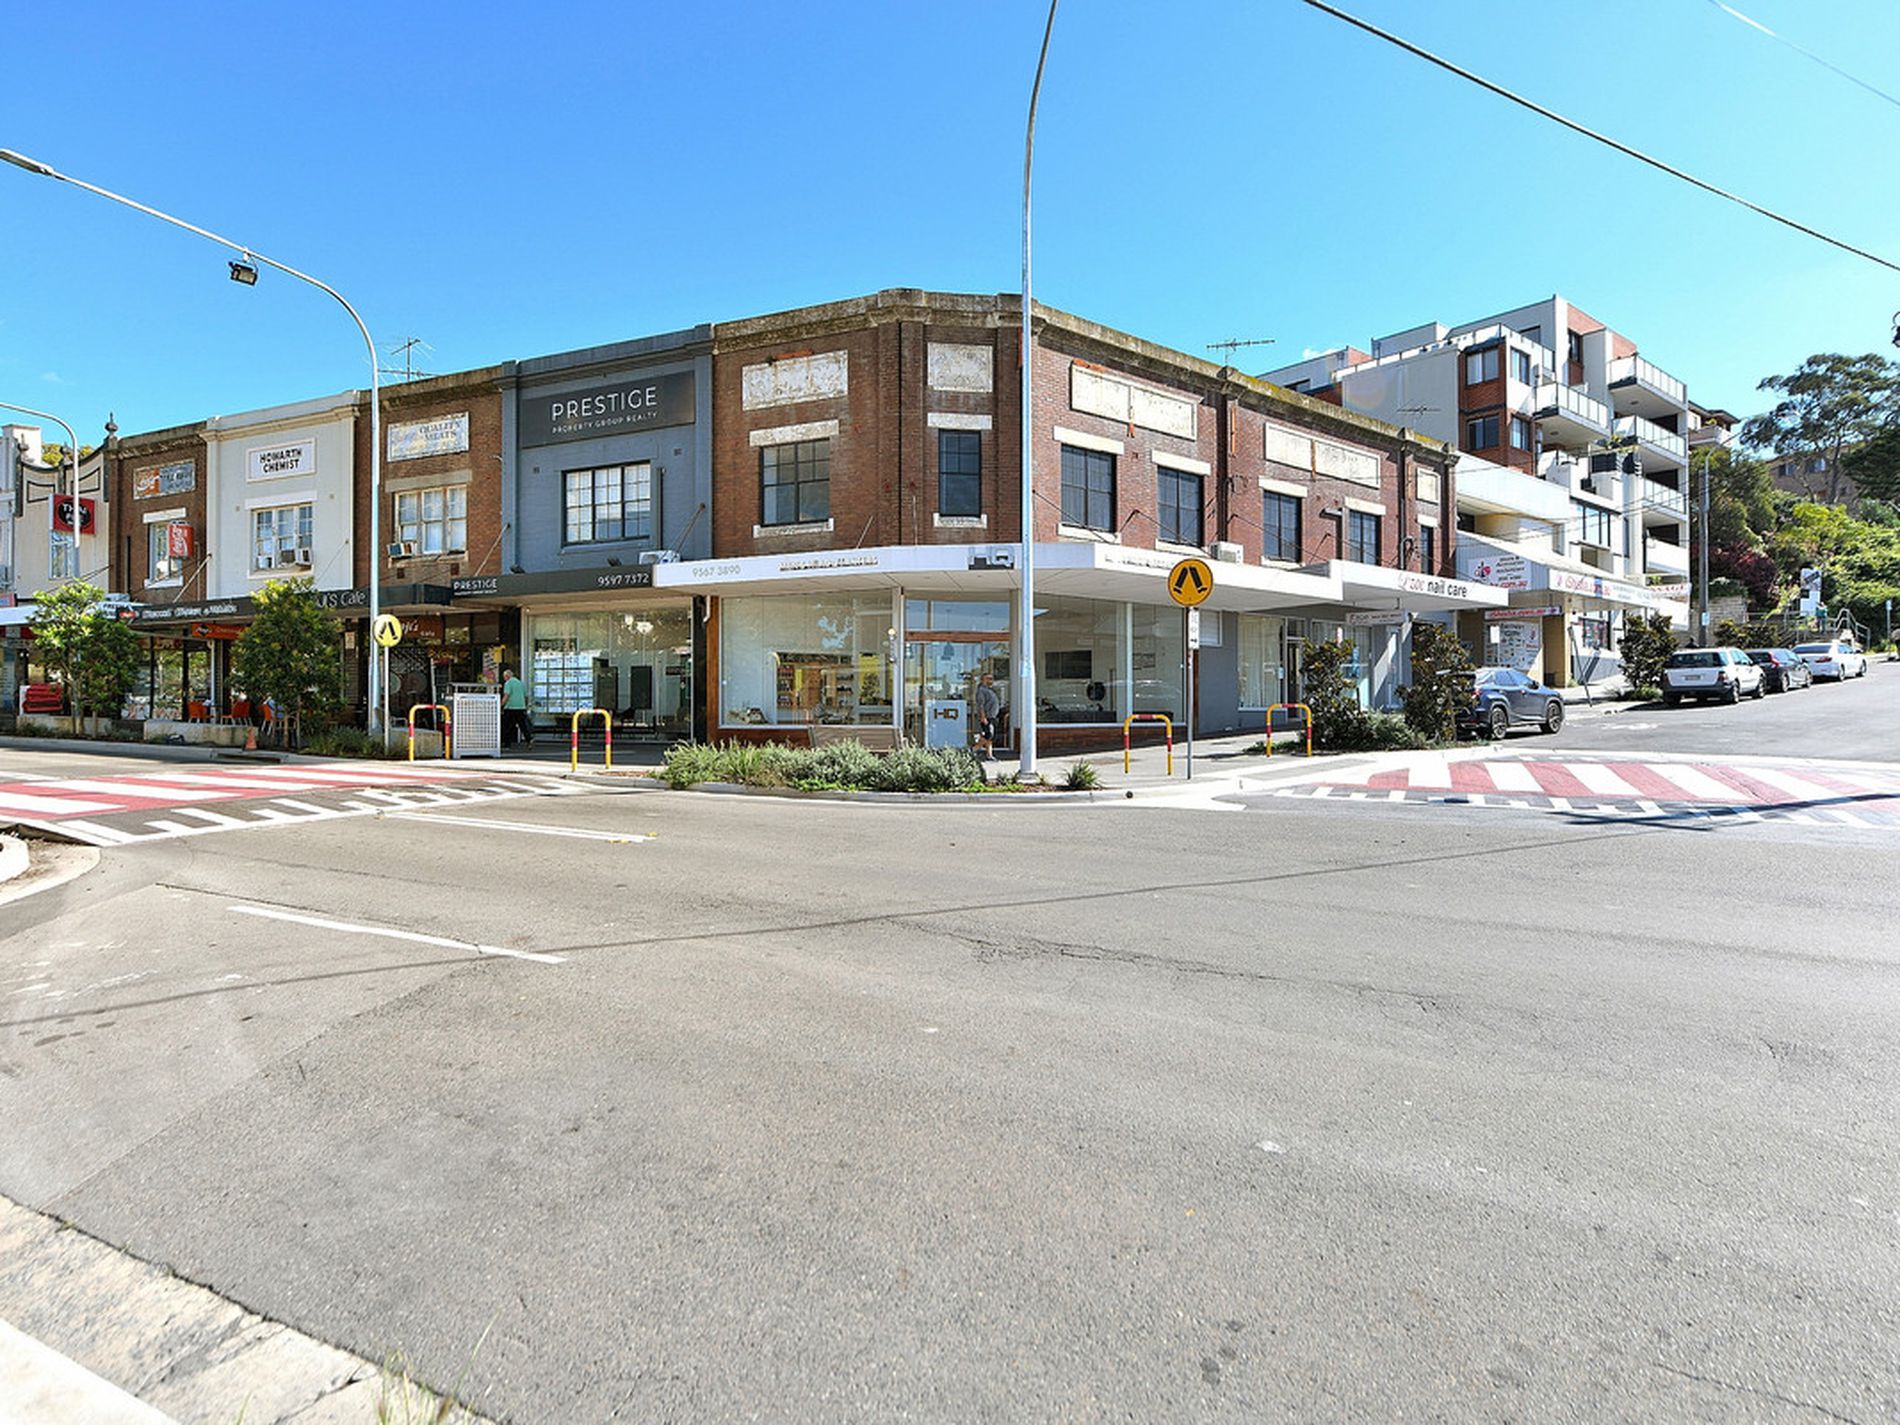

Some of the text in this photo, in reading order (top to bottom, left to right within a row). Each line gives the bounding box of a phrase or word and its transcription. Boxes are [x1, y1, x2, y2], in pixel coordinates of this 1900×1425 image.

[552, 386, 657, 421] PRESTIGE
[552, 411, 657, 433] PROPERTY GROUP REALTY
[260, 448, 302, 463] HOWARTH
[263, 459, 299, 473] CHEMIST
[968, 546, 1015, 570] HQ
[692, 565, 741, 577] 9567 3890
[453, 578, 497, 590] PRESTIGE
[598, 575, 622, 586] 9597
[1427, 580, 1445, 594] nail
[1447, 583, 1468, 597] care
[341, 591, 366, 606] Cafe
[933, 708, 959, 720] HQ
